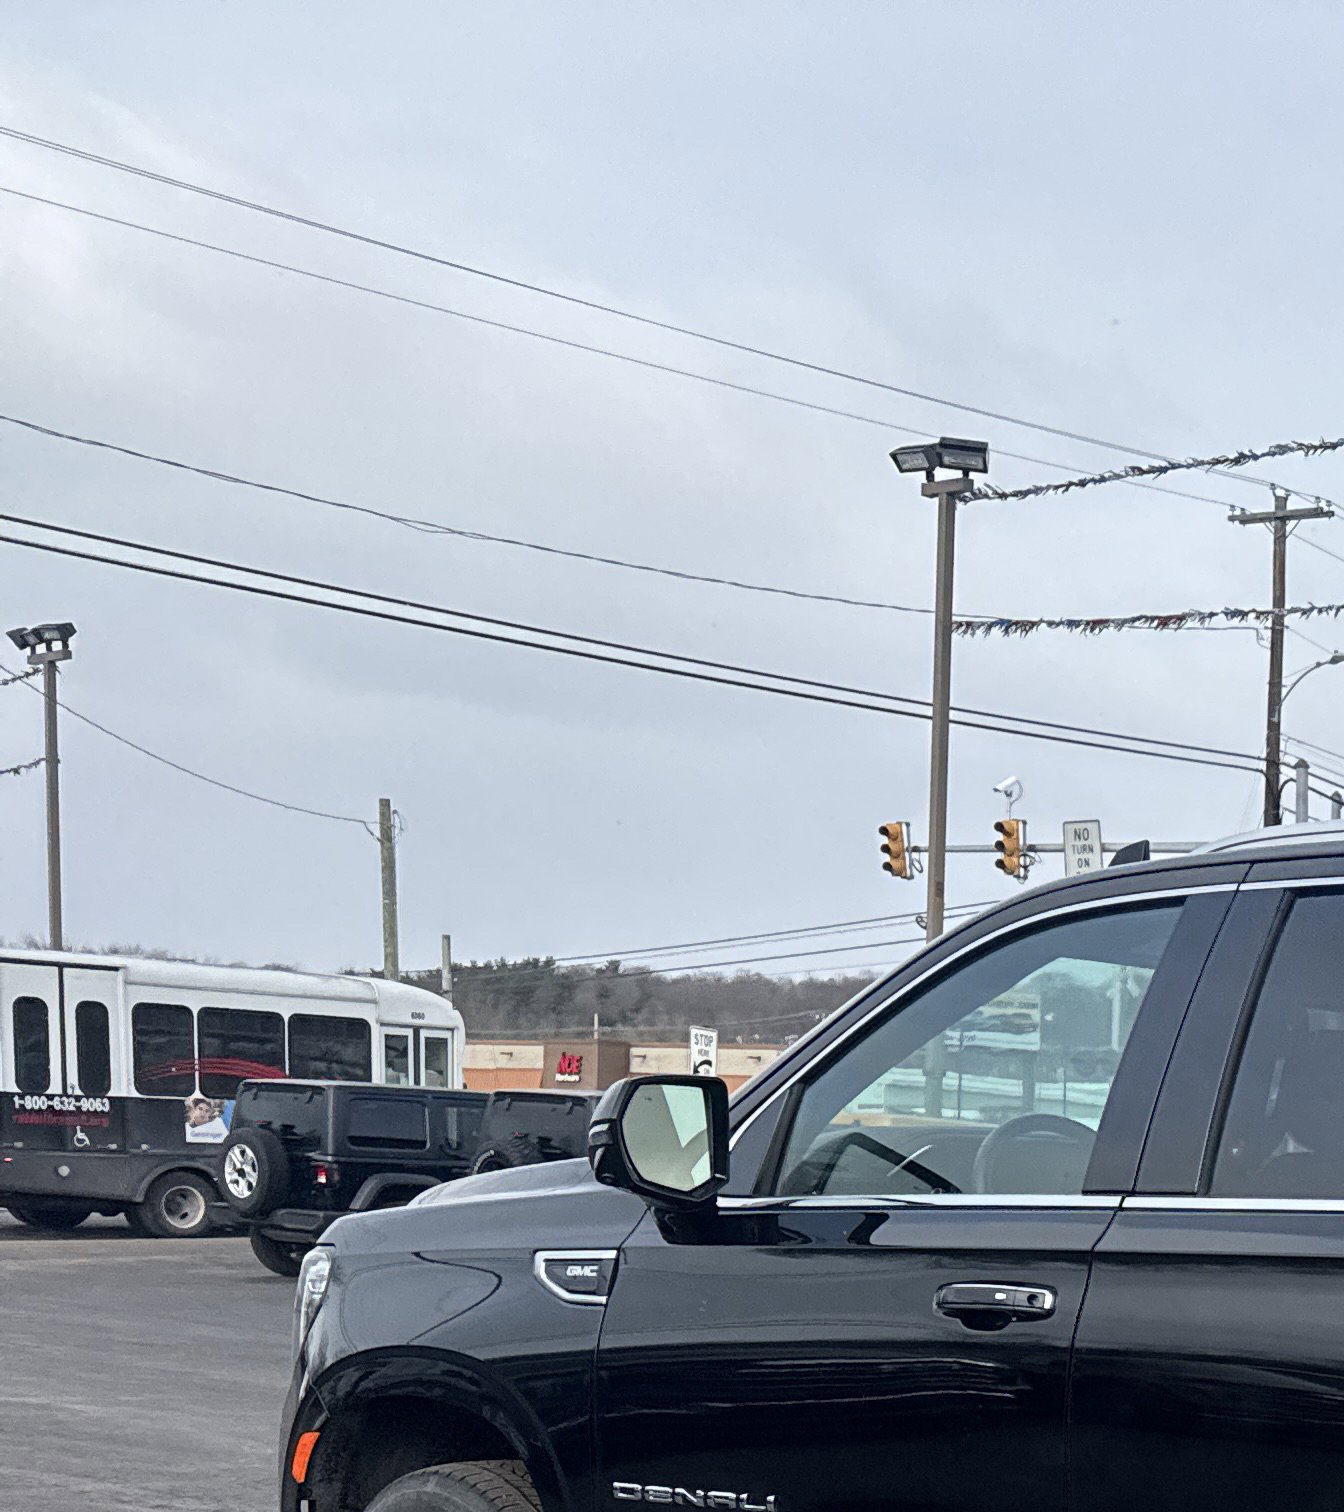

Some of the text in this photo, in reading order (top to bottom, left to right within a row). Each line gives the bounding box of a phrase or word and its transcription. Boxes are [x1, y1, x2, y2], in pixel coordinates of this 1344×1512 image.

[1073, 827, 1090, 842] NO
[1071, 843, 1094, 855] TURN
[1077, 857, 1090, 868] ON
[694, 1032, 714, 1048] STOP
[556, 1052, 582, 1074] ACE
[565, 1265, 599, 1277] GMC
